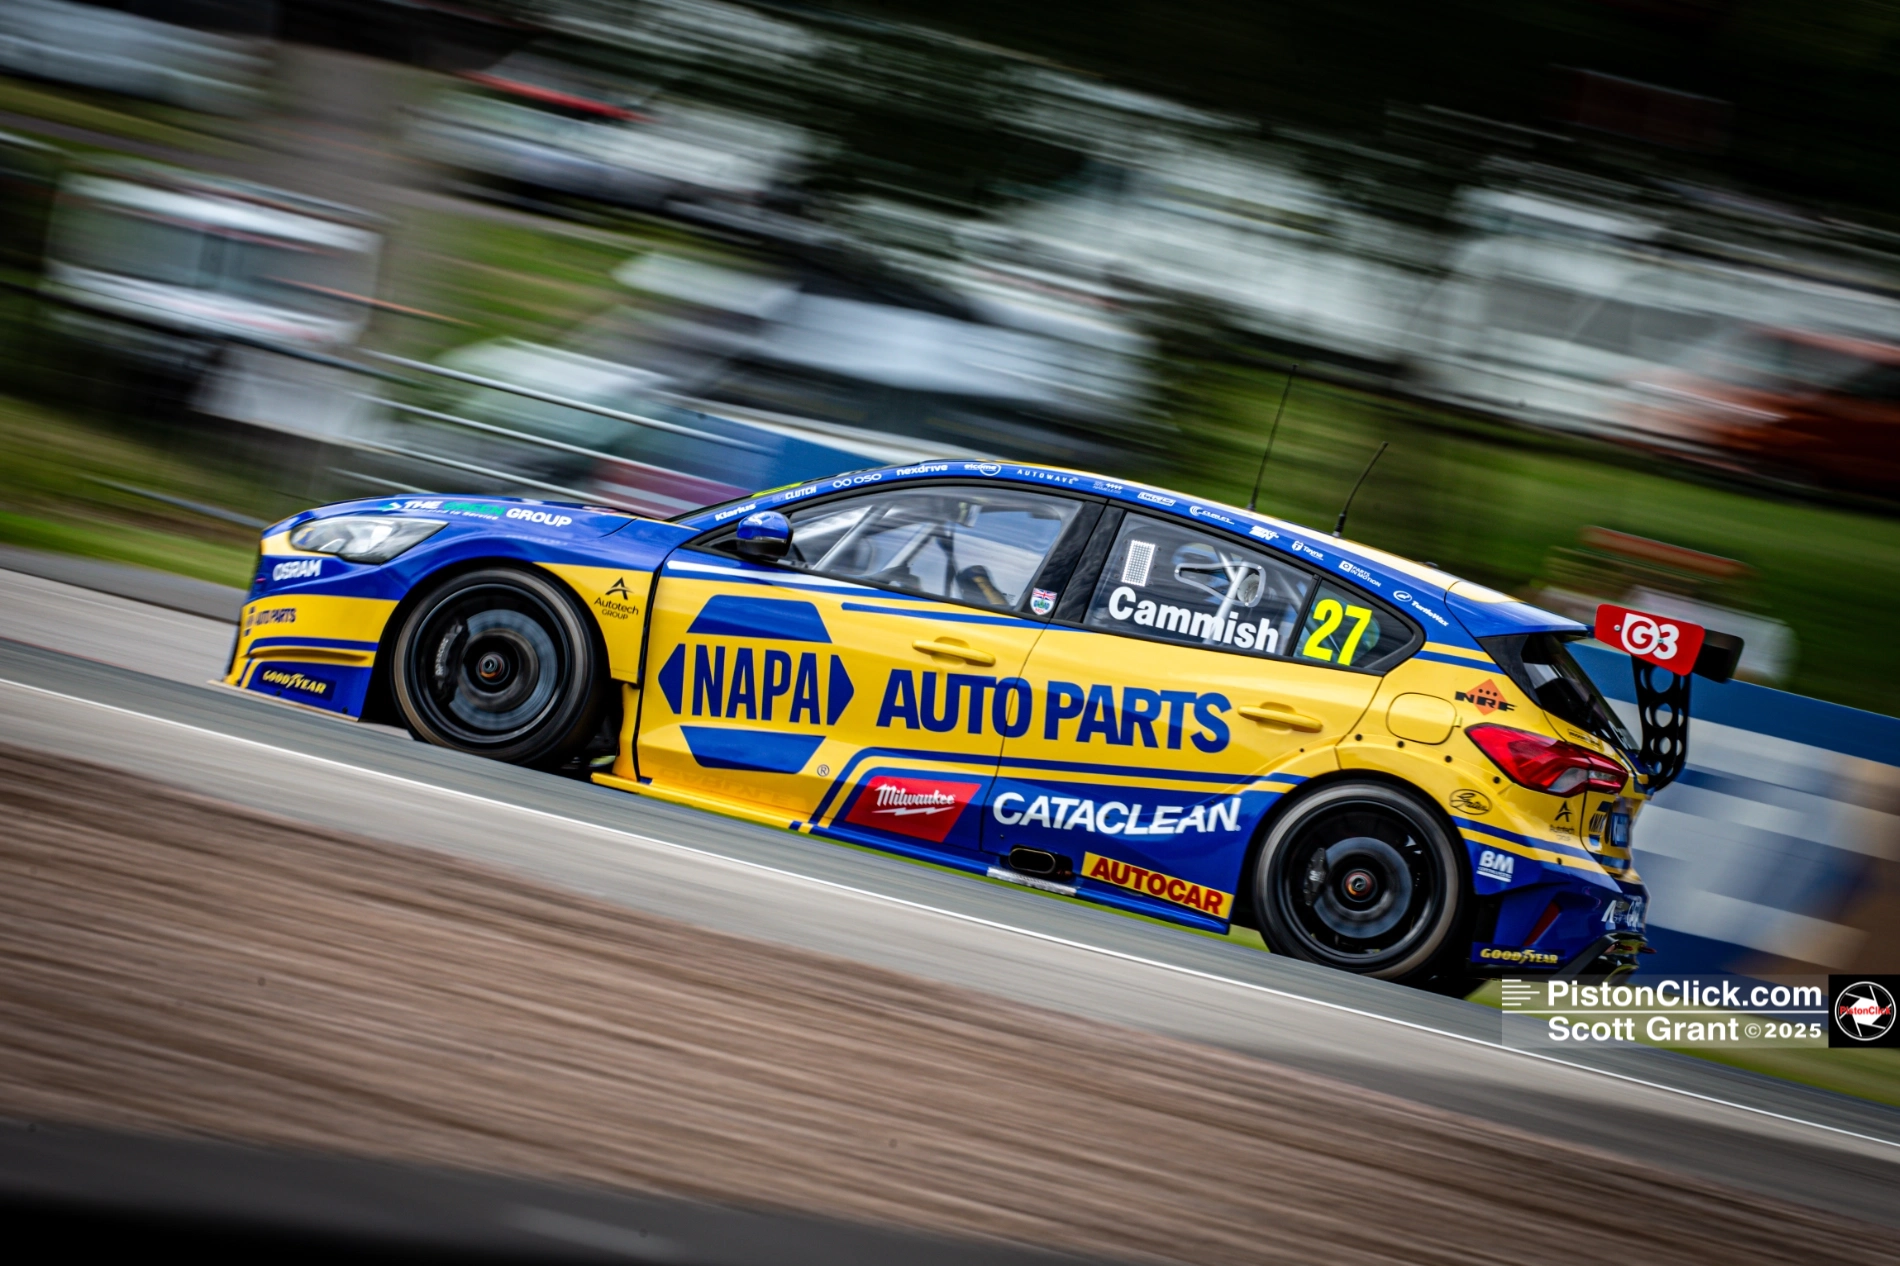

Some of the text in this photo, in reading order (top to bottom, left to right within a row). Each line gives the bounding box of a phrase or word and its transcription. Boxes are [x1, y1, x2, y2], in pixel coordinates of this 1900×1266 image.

[895, 463, 949, 477] nexdrive
[1016, 468, 1074, 485] AUTOWAVE
[784, 486, 817, 501] CLUTCH
[403, 499, 573, 527] THE GREEN GROUP
[714, 502, 757, 521] Klarius
[272, 558, 323, 581] OSRAM
[1357, 572, 1382, 588] MOTION
[270, 607, 297, 623] PARTS
[593, 597, 640, 615] Autotech
[601, 608, 629, 620] GROUP
[1108, 586, 1280, 654] Cammish
[1302, 598, 1372, 666] 27
[1621, 613, 1680, 660] G3
[262, 669, 327, 694] GOODYEAR
[691, 643, 1232, 754] NAPA AUTO PARTS
[1455, 691, 1518, 712] NRF
[873, 782, 956, 807] Milwaukee
[992, 791, 1242, 836] CATACLEAN
[1478, 850, 1515, 874] BM
[1090, 858, 1224, 915] AUTOCAR
[1480, 948, 1559, 964] GOODYEAR
